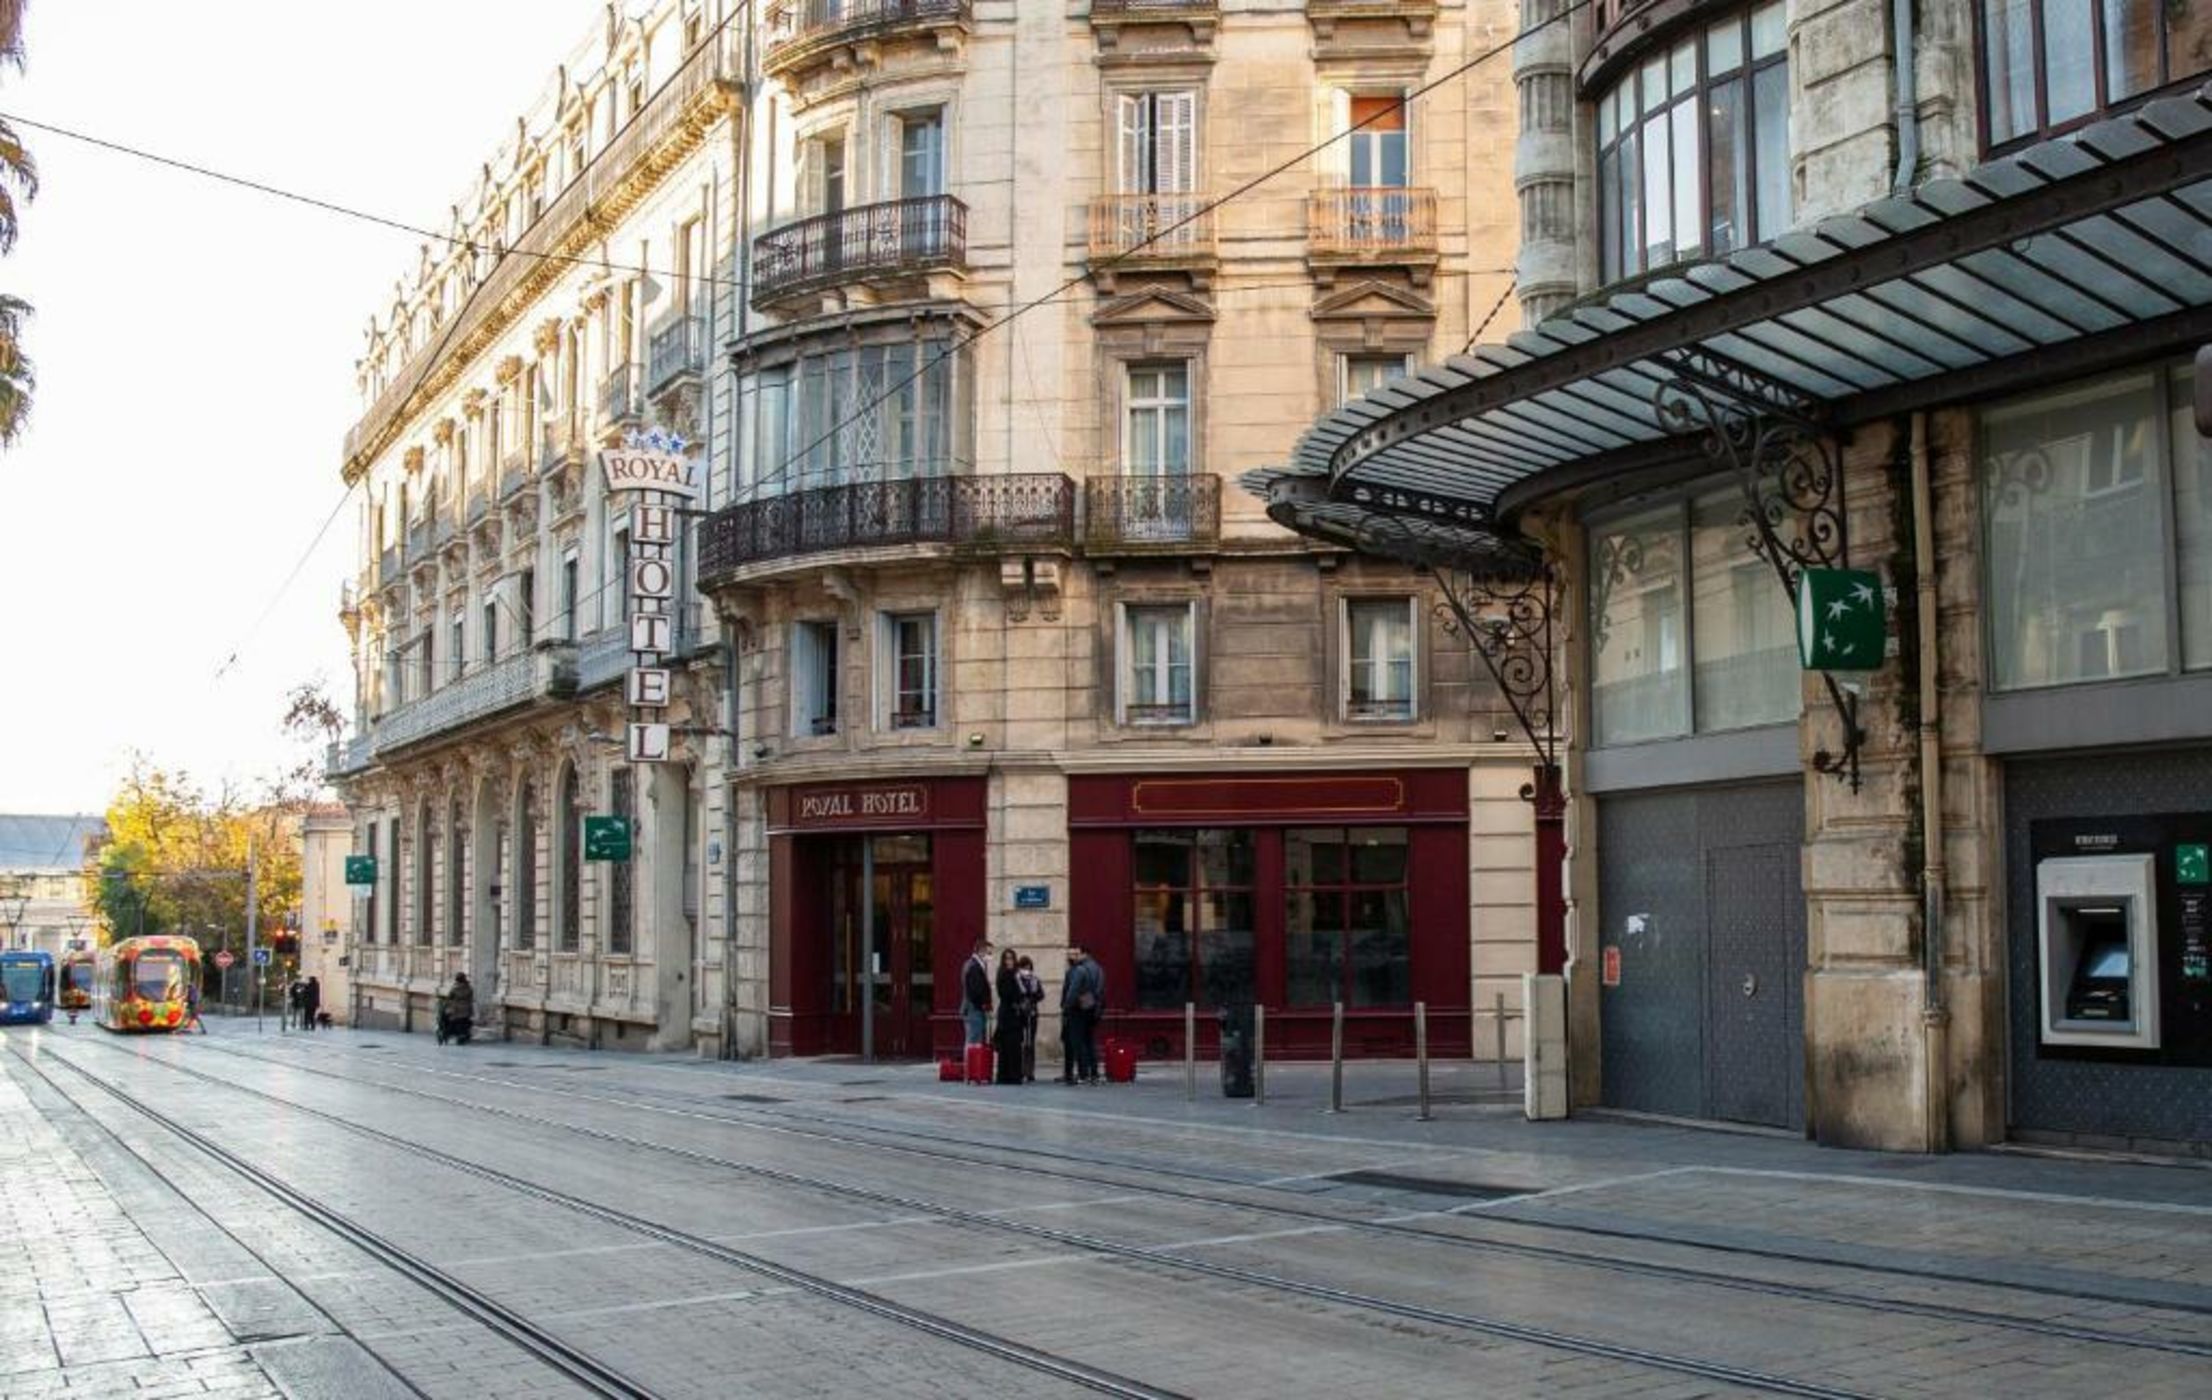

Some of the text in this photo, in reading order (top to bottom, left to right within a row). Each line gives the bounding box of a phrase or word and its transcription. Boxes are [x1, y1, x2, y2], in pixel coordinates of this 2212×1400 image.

[609, 456, 698, 488] ROYAL
[635, 506, 672, 759] HOTEL
[801, 792, 920, 818] ROYAL HOTEL
